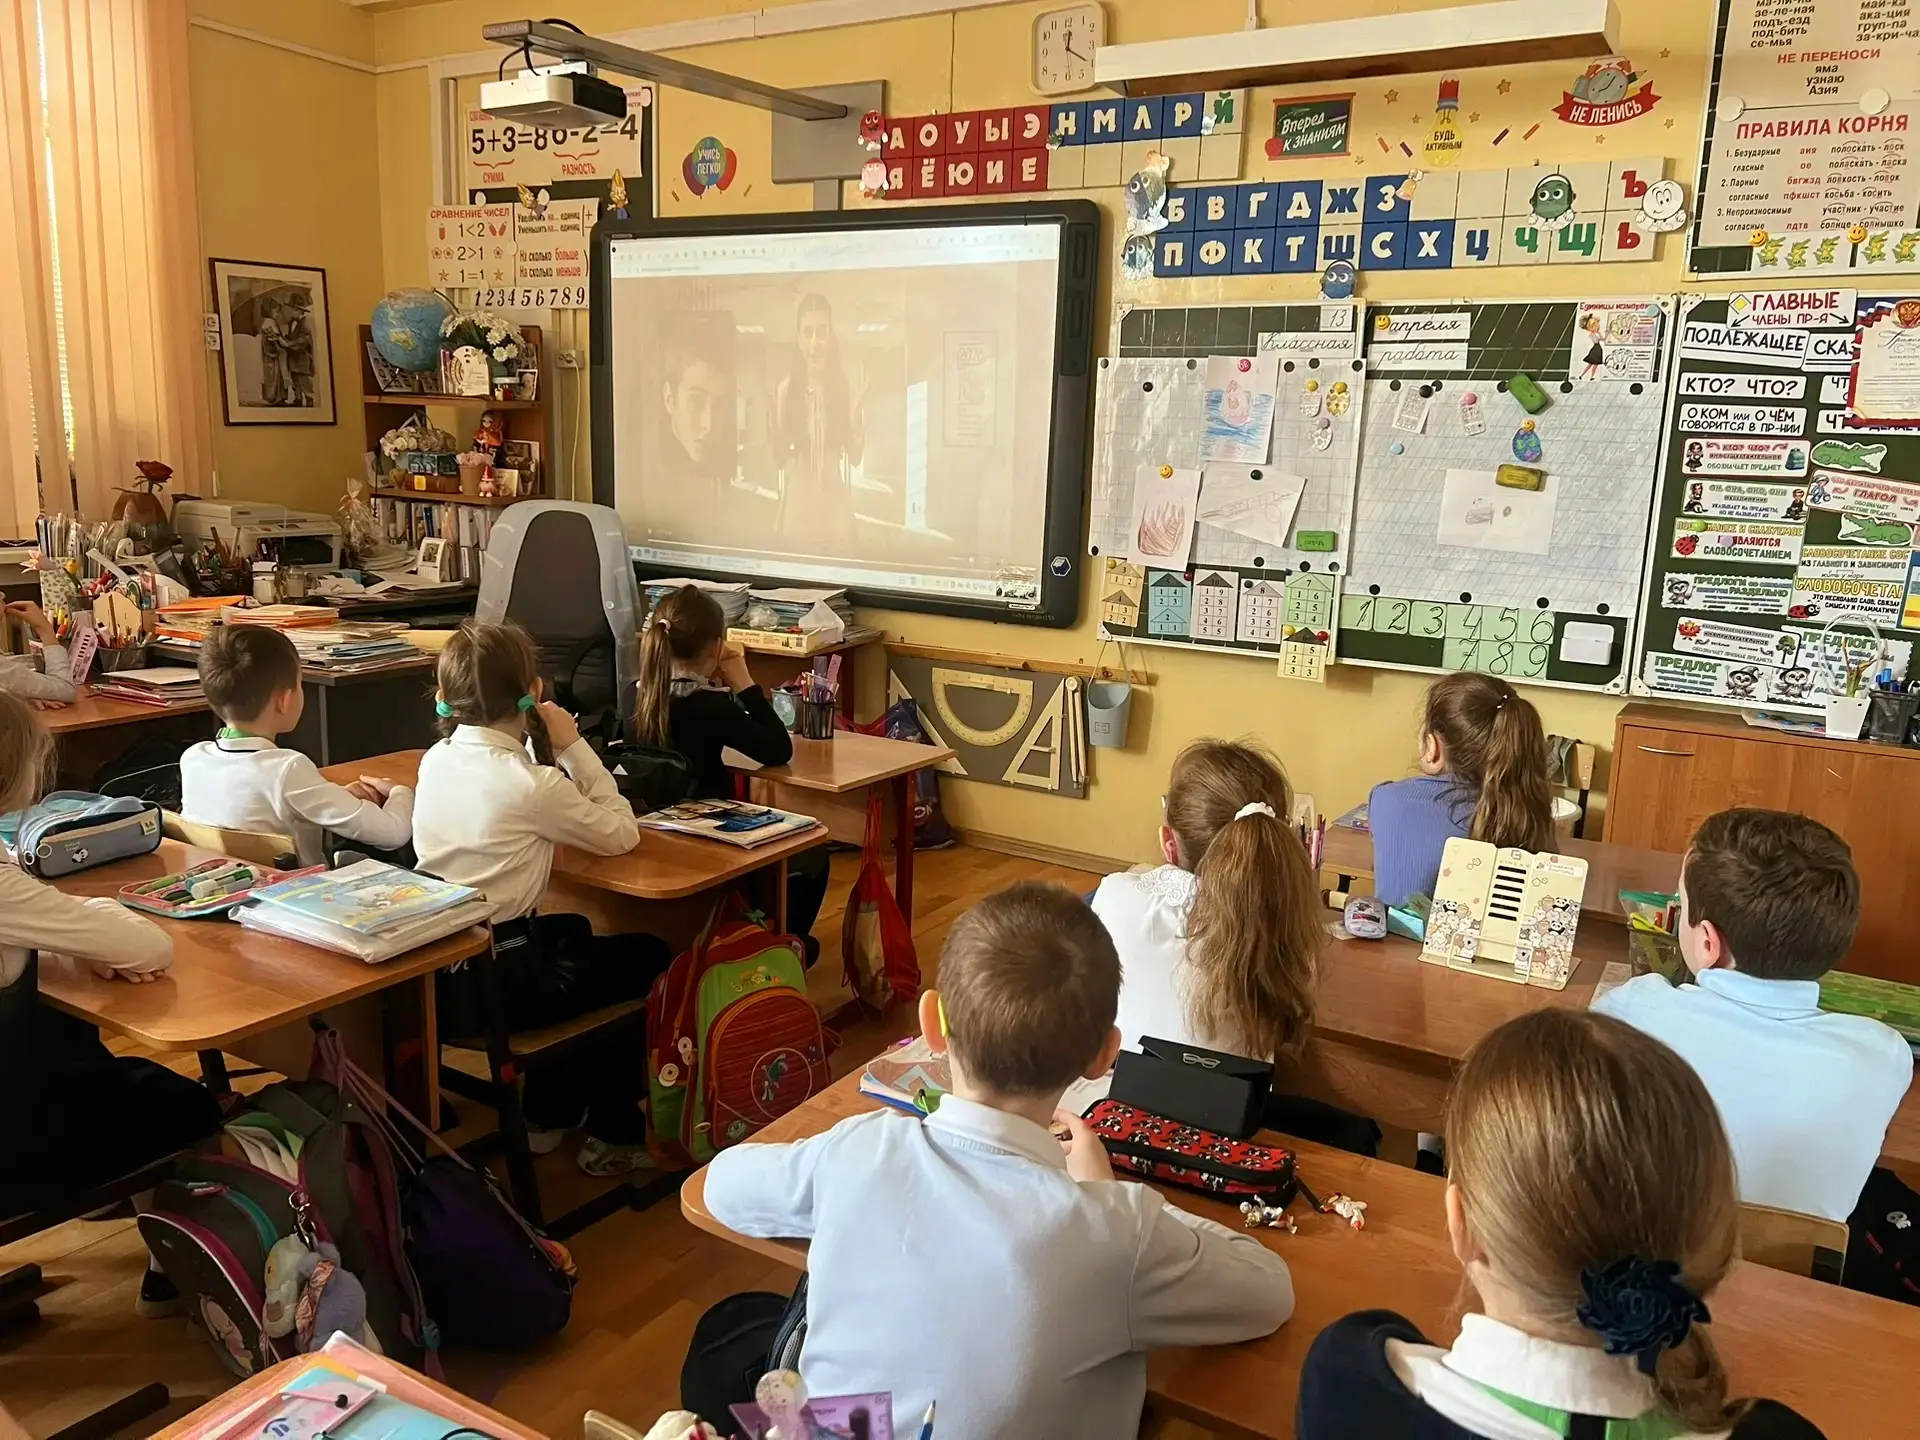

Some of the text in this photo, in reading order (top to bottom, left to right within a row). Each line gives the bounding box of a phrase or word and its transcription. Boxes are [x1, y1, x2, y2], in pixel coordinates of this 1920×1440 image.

[1755, 5, 1815, 17] зе-ле-ная
[1860, 9, 1910, 20] ака-ция
[1052, 21, 1057, 30] 11
[1065, 17, 1073, 28] 12
[1753, 16, 1810, 28] подъ-езд
[1857, 20, 1907, 32] груп-па
[1043, 31, 1051, 41] 10
[1752, 26, 1807, 38] под-бить
[1750, 38, 1792, 48] се-мья
[1042, 48, 1048, 58] 9
[1777, 48, 1881, 63] НЕ ПЕРЕНОСИ
[1042, 66, 1048, 76] 8
[1815, 65, 1839, 73] яма
[1806, 75, 1845, 86] узнаю
[1808, 85, 1839, 95] Азия
[1569, 99, 1642, 124] НЕ ЛЕНИСЬ
[889, 92, 1234, 150] А О У Ы Э Н М Л Р Й
[1280, 111, 1325, 136] Вперед
[1736, 114, 1908, 140] ПРАВИЛА КОРНЯ
[1283, 122, 1347, 152] К ЗНАНИЯМ
[1433, 130, 1456, 141] БУДЬ
[1425, 140, 1463, 151] АКТИВНЫМ
[698, 148, 720, 160] УЧИСЬ
[1734, 148, 1781, 159] Безударные
[561, 163, 596, 176] РАЗНОСТЬ
[697, 162, 720, 175] ЛЕГКО!
[889, 156, 1037, 190] Я Ё Ю И Е
[1732, 163, 1764, 172] гласные
[483, 172, 505, 184] СУММА
[1730, 179, 1759, 188] Парные
[1620, 170, 1648, 199] Ъ
[1729, 189, 1892, 201] согласные пфкшст косьба косить
[1167, 184, 1396, 223] Б В Г Д Ж З
[430, 207, 510, 219] СРАВНЕНИЕ ЧИСЕЛ
[1726, 204, 1905, 217] Непроизносимые участник участие
[560, 213, 581, 221] единиц
[518, 223, 580, 234] Уменьшить единиц
[1725, 223, 1765, 231] согласные
[1163, 221, 1641, 267] П Ф К Т Ш С Х Ц Ч Щ Ь
[519, 249, 579, 261] На сколько больше
[519, 266, 581, 277] На сколько меньше
[1752, 291, 1840, 311] ГЛАВНЫЕ
[1328, 309, 1348, 328] 13
[1752, 312, 1829, 326] ЧЛЕНЫ ПР-Я
[1683, 326, 1806, 352] ПОДЛЕЖАЩЕЕ
[1685, 377, 1799, 397] КТО? ЧТО?
[1687, 407, 1795, 423] О КОМ О ЧЁМ
[1681, 419, 1801, 434] ГОВОРИТСЯ В ПР-НИИ
[1853, 488, 1898, 504] ГЛАГОЛ
[1854, 500, 1889, 510] ОБОЗНАЧАЕТ
[1748, 525, 1803, 536] СКАЗУЕМОЕ
[1703, 546, 1792, 559] СЛОВОСОЧЕТАНИЕМ
[1802, 547, 1887, 560] СЛОВОСОЧЕТАНИЕ
[1813, 560, 1849, 568] ГЛАВНОГО
[1858, 561, 1906, 569] ЗАВИСИМОГО
[1693, 576, 1747, 587] ПРЕДЛОГИ
[1729, 587, 1789, 598] РАЗДЕЛЬНО
[1825, 595, 1858, 603] НЕСКОЛЬКО
[1824, 602, 1850, 610] СМЫСЛУ
[1356, 599, 1555, 644] 1 2 3 4 5 6
[1459, 638, 1548, 677] 7 8 9
[1655, 655, 1722, 673] ПРЕДЛОГ
